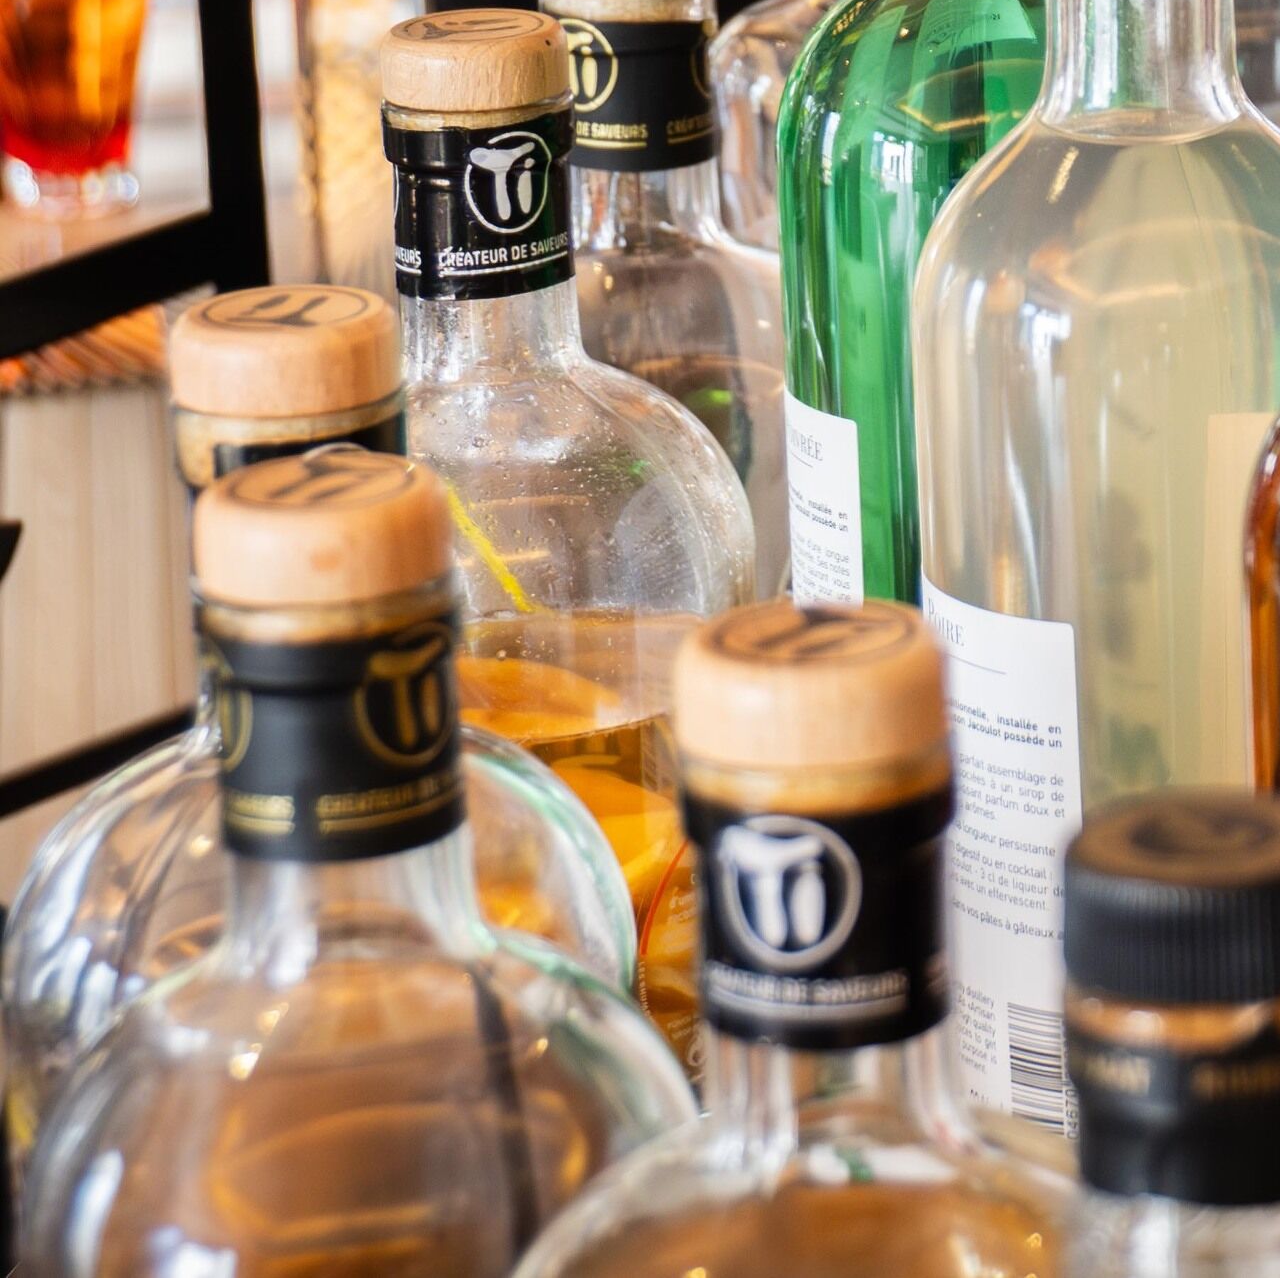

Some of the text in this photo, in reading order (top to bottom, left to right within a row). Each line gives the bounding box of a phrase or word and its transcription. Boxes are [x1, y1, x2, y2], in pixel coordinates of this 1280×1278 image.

[469, 141, 535, 221] Ti
[438, 231, 568, 270] CRÉATEUR DE SAVEURS
[997, 713, 1038, 732] installée
[1048, 724, 1062, 735] en
[1004, 730, 1045, 748] possède
[1048, 737, 1063, 749] un
[987, 761, 1046, 786] assemblage
[1050, 773, 1064, 786] de
[985, 793, 1019, 811] parfum
[1023, 801, 1049, 817] doux
[1054, 808, 1065, 818] et
[1000, 783, 1014, 795] un
[1019, 786, 1045, 801] sirop
[1051, 789, 1064, 803] de
[999, 837, 1056, 858] persistante
[982, 855, 993, 867] ou
[995, 859, 1006, 871] en
[1008, 861, 1047, 880] cocktail
[717, 823, 827, 950] Ti
[998, 875, 1009, 887] de
[1013, 877, 1048, 897] liqueur
[980, 906, 1003, 928] pâtes
[1013, 919, 1054, 940] gâteaux
